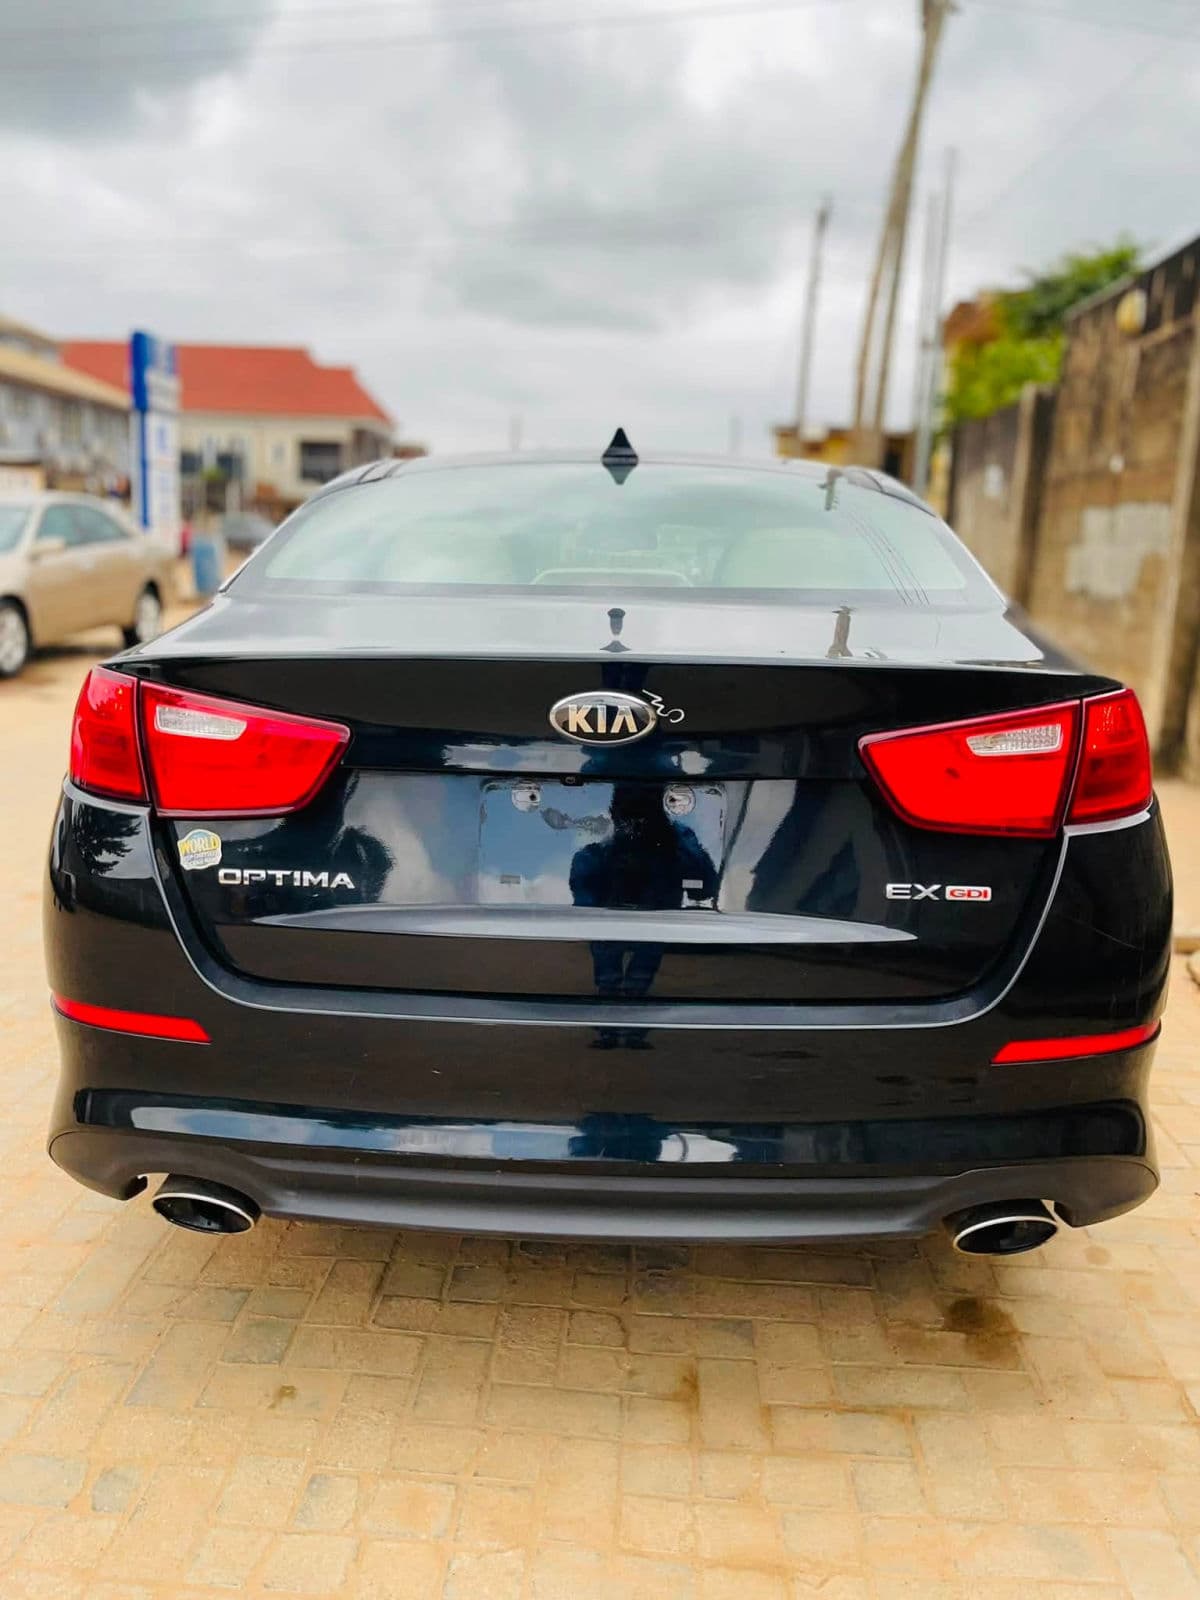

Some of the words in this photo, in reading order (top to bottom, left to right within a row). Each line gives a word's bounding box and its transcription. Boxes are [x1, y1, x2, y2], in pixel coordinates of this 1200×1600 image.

[568, 704, 638, 733] KIA
[218, 868, 356, 889] OPTIMA
[886, 883, 942, 900] EX
[948, 888, 989, 899] GDI
